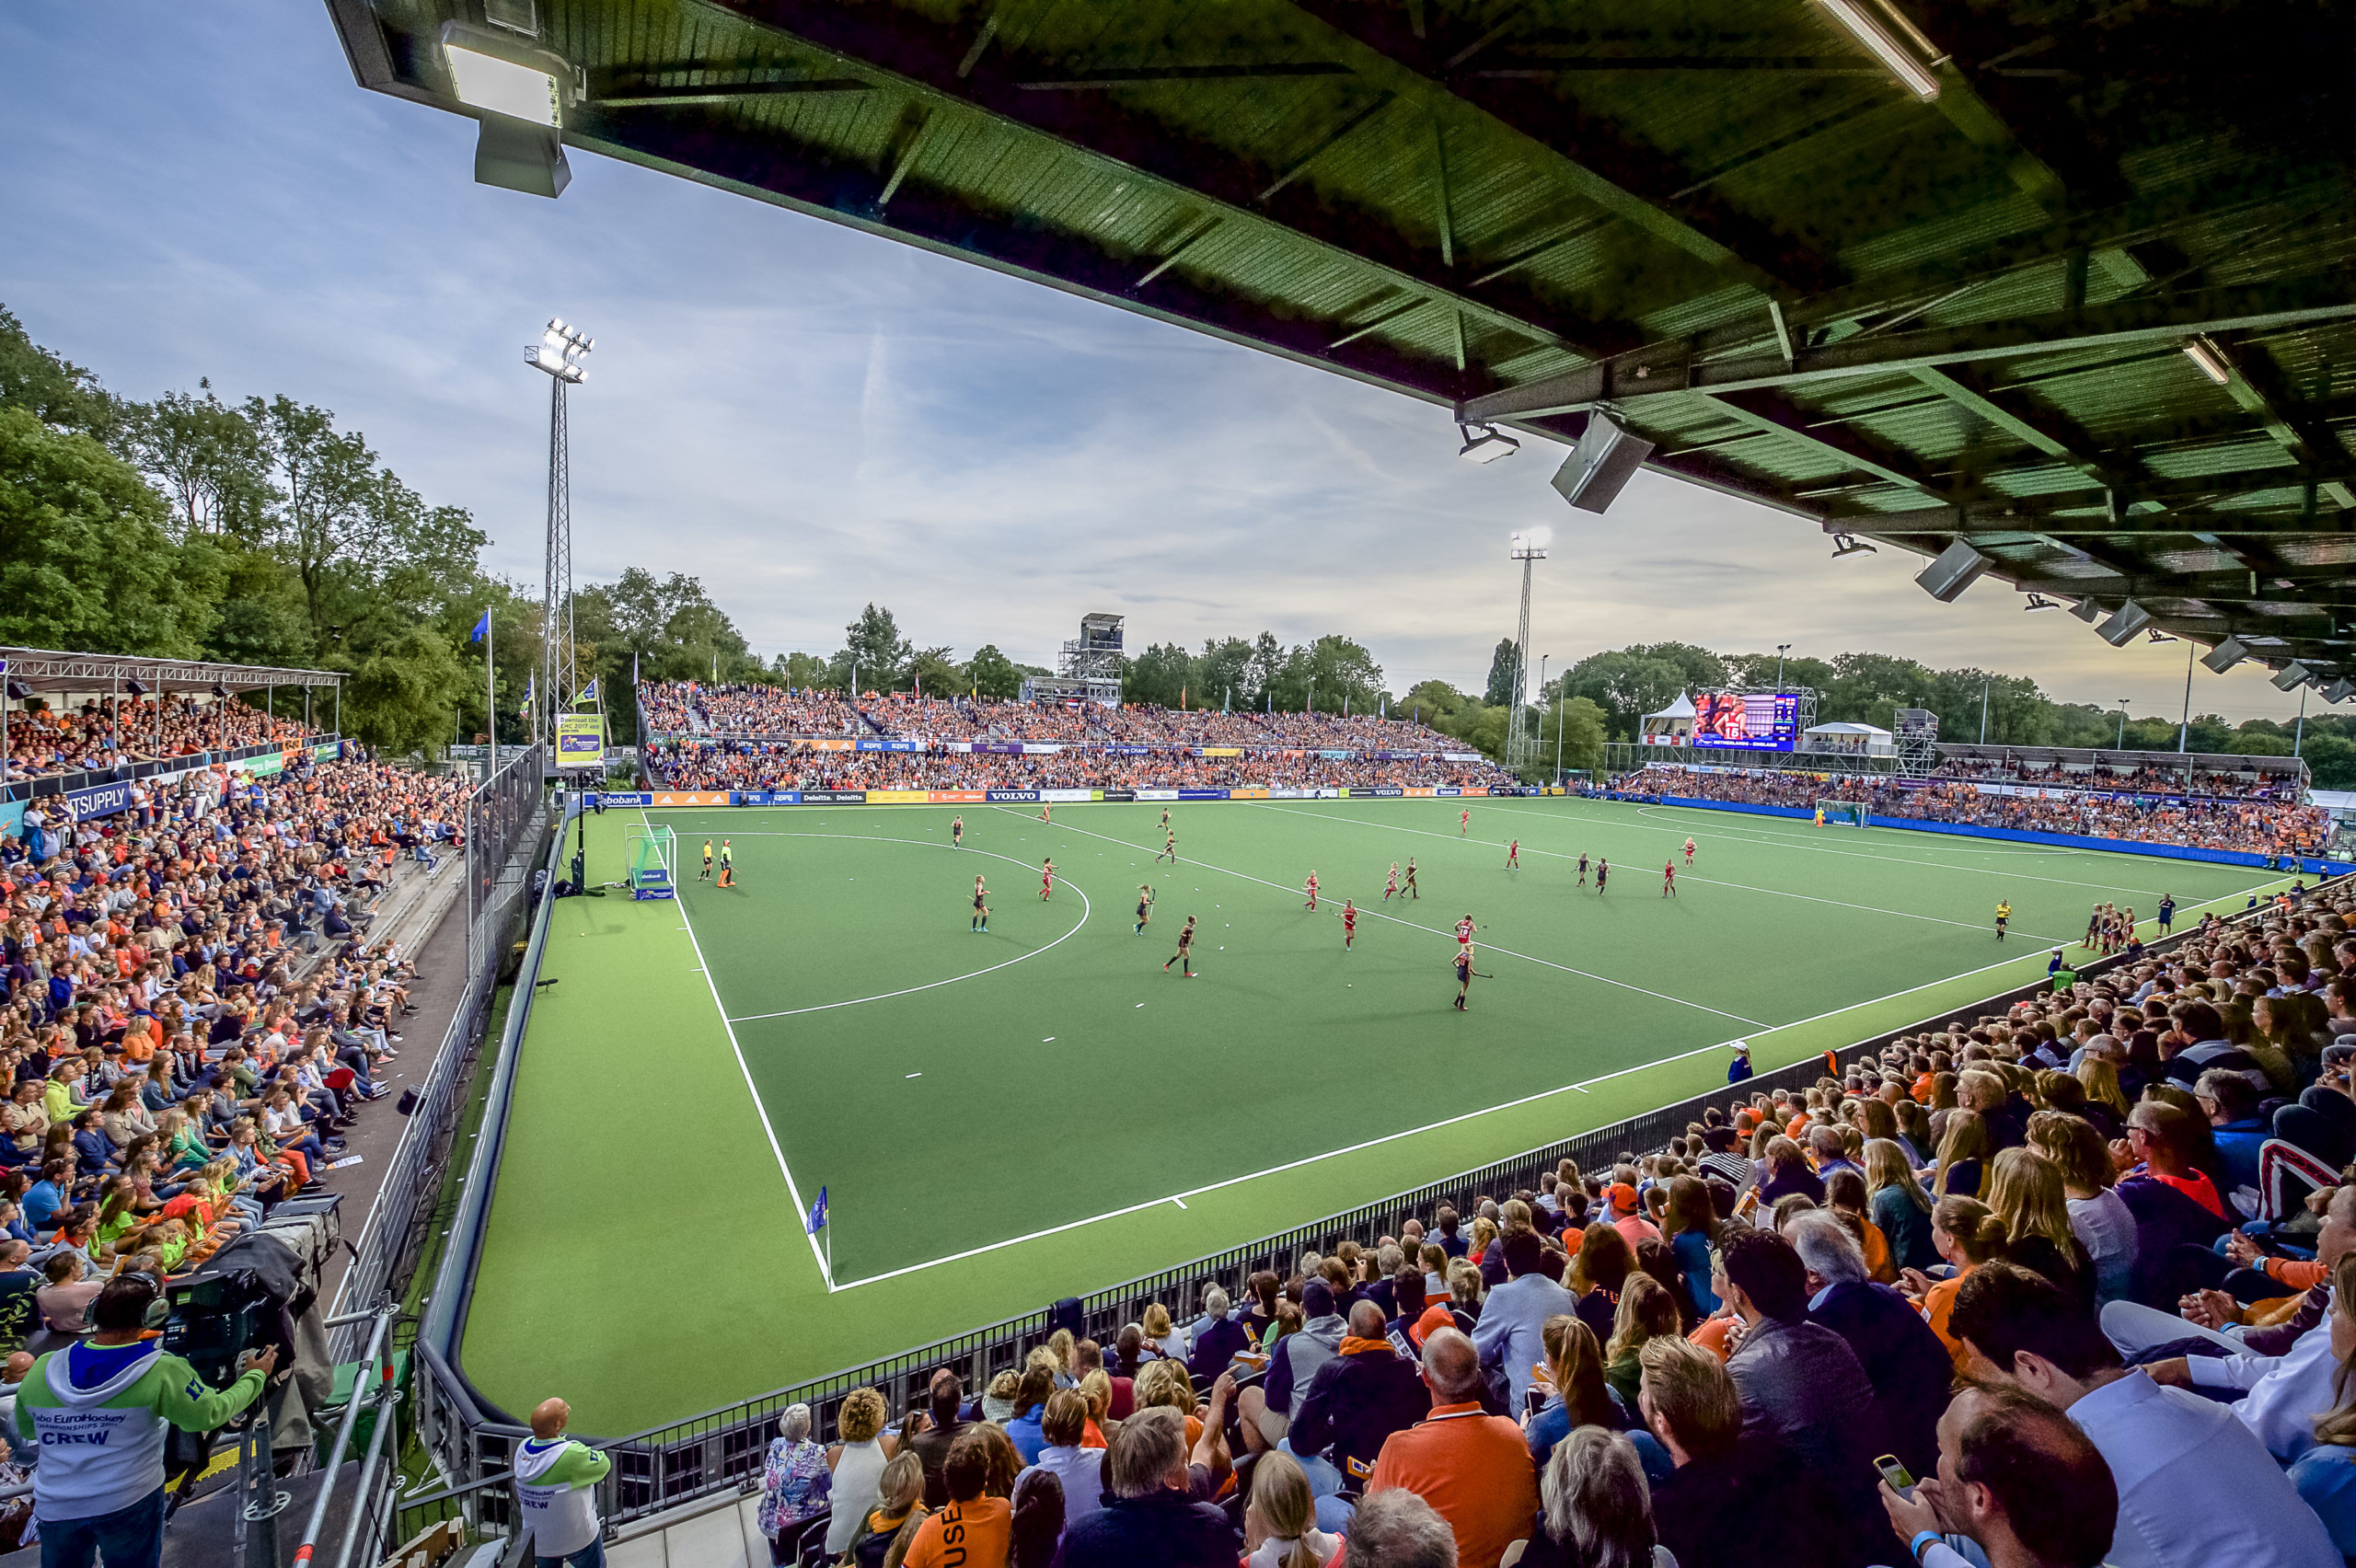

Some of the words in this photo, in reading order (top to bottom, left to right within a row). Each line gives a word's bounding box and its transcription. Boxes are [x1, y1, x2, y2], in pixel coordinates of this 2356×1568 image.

[862, 742, 883, 750] auping
[891, 743, 910, 751] auping
[606, 794, 642, 804] bobank
[1832, 819, 1856, 827] Rabobank
[2161, 847, 2185, 857] Get
[2187, 848, 2245, 864] inspired
[2247, 856, 2263, 865] at
[185, 1377, 205, 1402] 17
[53, 1413, 127, 1424] EuroHockey
[37, 1423, 98, 1432] CHAMPIONSHIPS
[41, 1429, 110, 1446] CREW
[941, 1505, 966, 1568] USE
